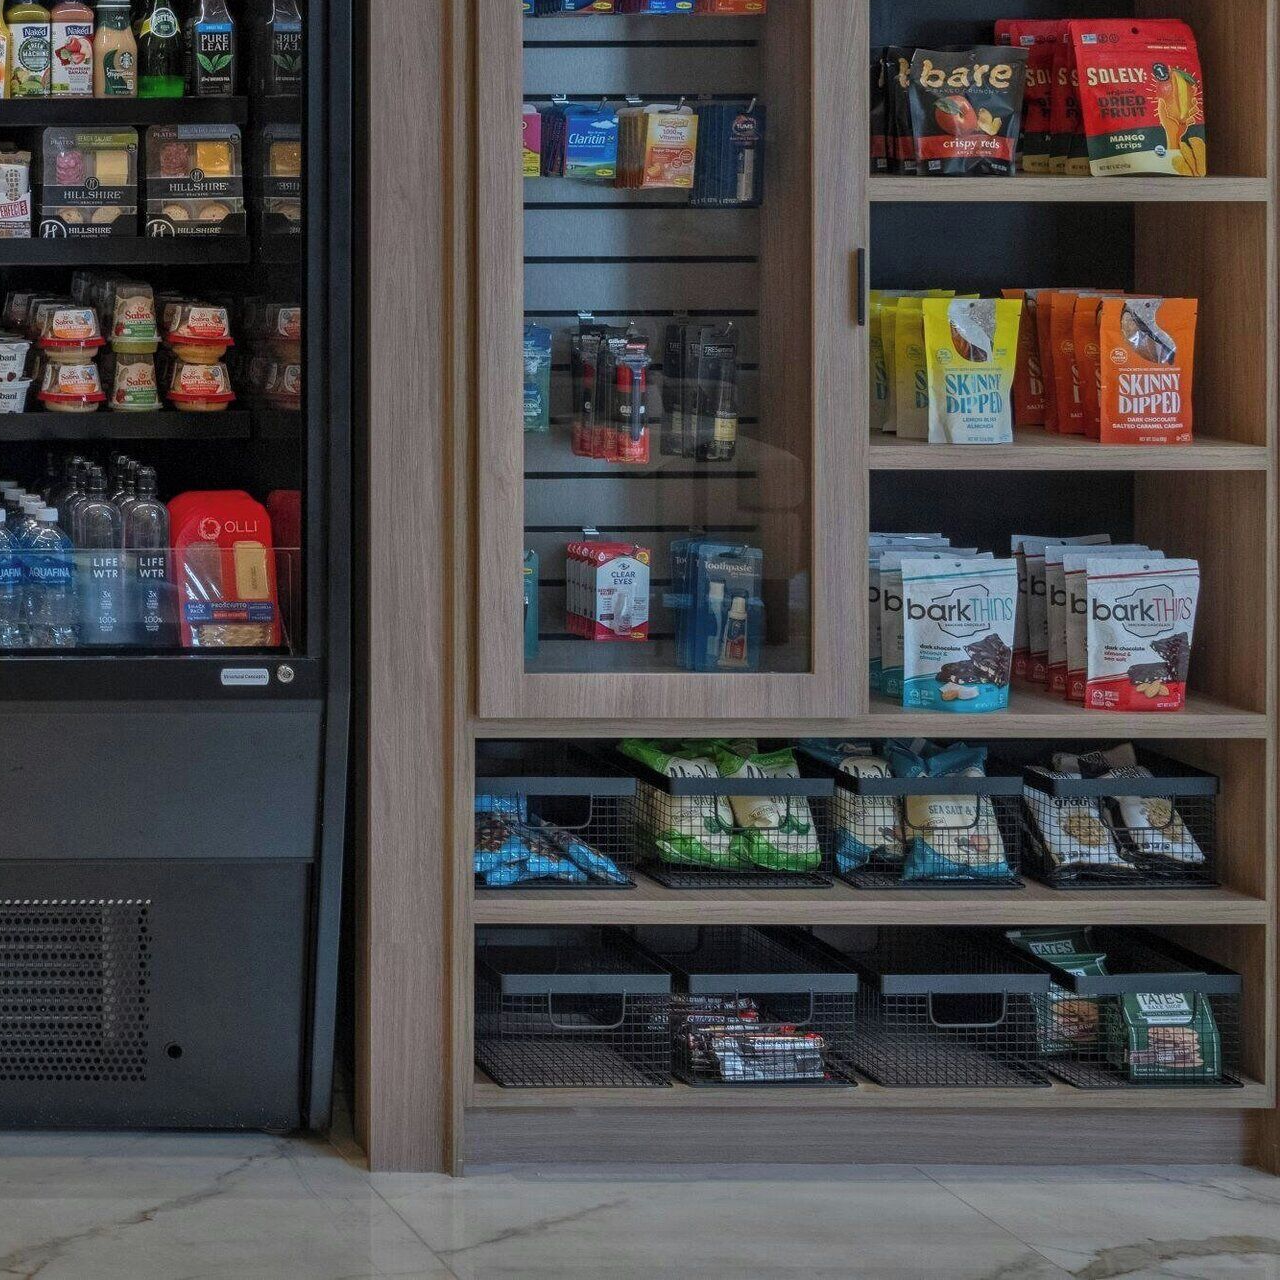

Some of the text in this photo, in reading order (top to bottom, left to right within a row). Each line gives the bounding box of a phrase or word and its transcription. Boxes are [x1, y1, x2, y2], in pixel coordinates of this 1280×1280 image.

[201, 34, 229, 42] PURE
[921, 59, 1012, 89] bare
[963, 87, 1001, 95] CRUNCHY
[1096, 96, 1146, 109] DRIED
[1099, 107, 1146, 118] FRUIT
[569, 133, 606, 145] Claritin
[1109, 134, 1145, 143] MANGO
[943, 138, 1000, 151] crispy reds
[1115, 141, 1142, 150] strips
[169, 183, 228, 191] HILLSHIRE
[64, 191, 122, 199] HILLSHIRE
[68, 227, 112, 235] HILLSHIRE
[125, 310, 152, 320] Sabra
[126, 376, 151, 386] Sabra
[945, 373, 1002, 396] SKINNY
[1118, 373, 1181, 395] SKINNY
[946, 392, 1003, 415] DIPPED
[1118, 391, 1181, 414] DIPPED
[224, 520, 257, 533] OLLI
[93, 558, 118, 567] LIFE
[140, 558, 164, 566] LIFE
[704, 560, 752, 574] Toothpaste
[29, 567, 70, 578] AQUAFINA
[93, 569, 118, 578] WTR
[139, 569, 164, 578] WTR
[611, 571, 636, 579] CLEAR
[613, 578, 633, 586] EYES
[928, 805, 964, 816] SEA SALT
